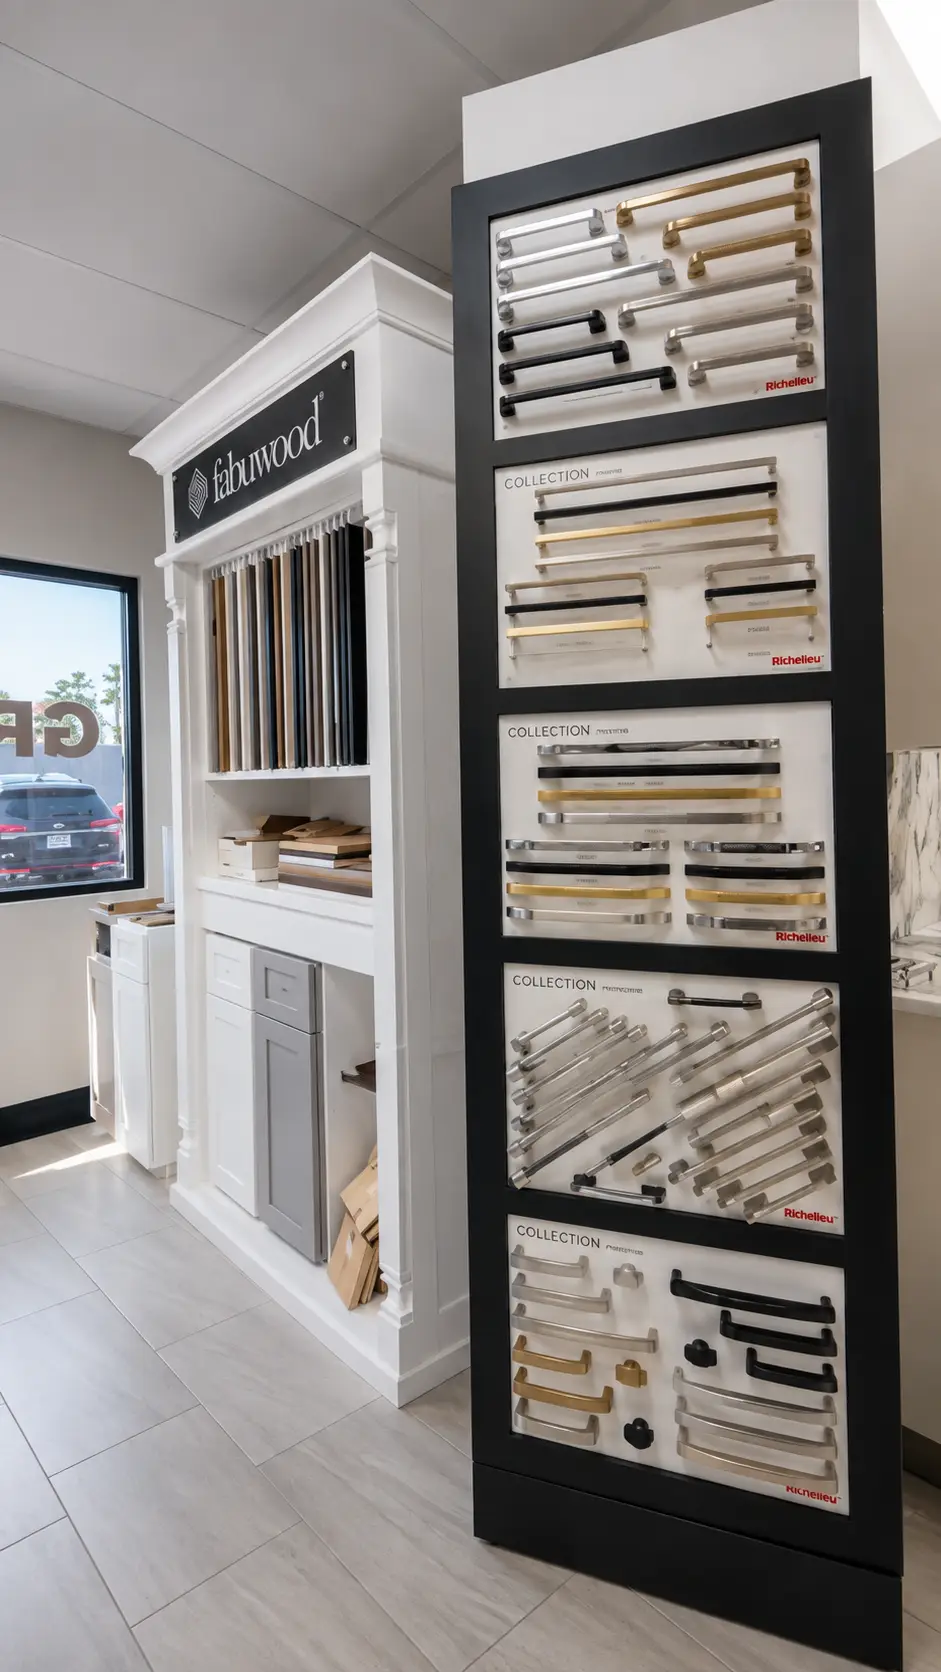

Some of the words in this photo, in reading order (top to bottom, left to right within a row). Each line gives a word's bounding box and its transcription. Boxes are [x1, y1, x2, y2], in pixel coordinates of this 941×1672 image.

[504, 468, 589, 490] COLLECTION
[772, 655, 821, 666] Richelieu
[508, 724, 590, 738] COLLECTION
[776, 931, 826, 943] Richelieu
[512, 974, 596, 991] COLLECTION
[784, 1207, 834, 1224] Richelieu
[516, 1225, 600, 1248] COLLECTION
